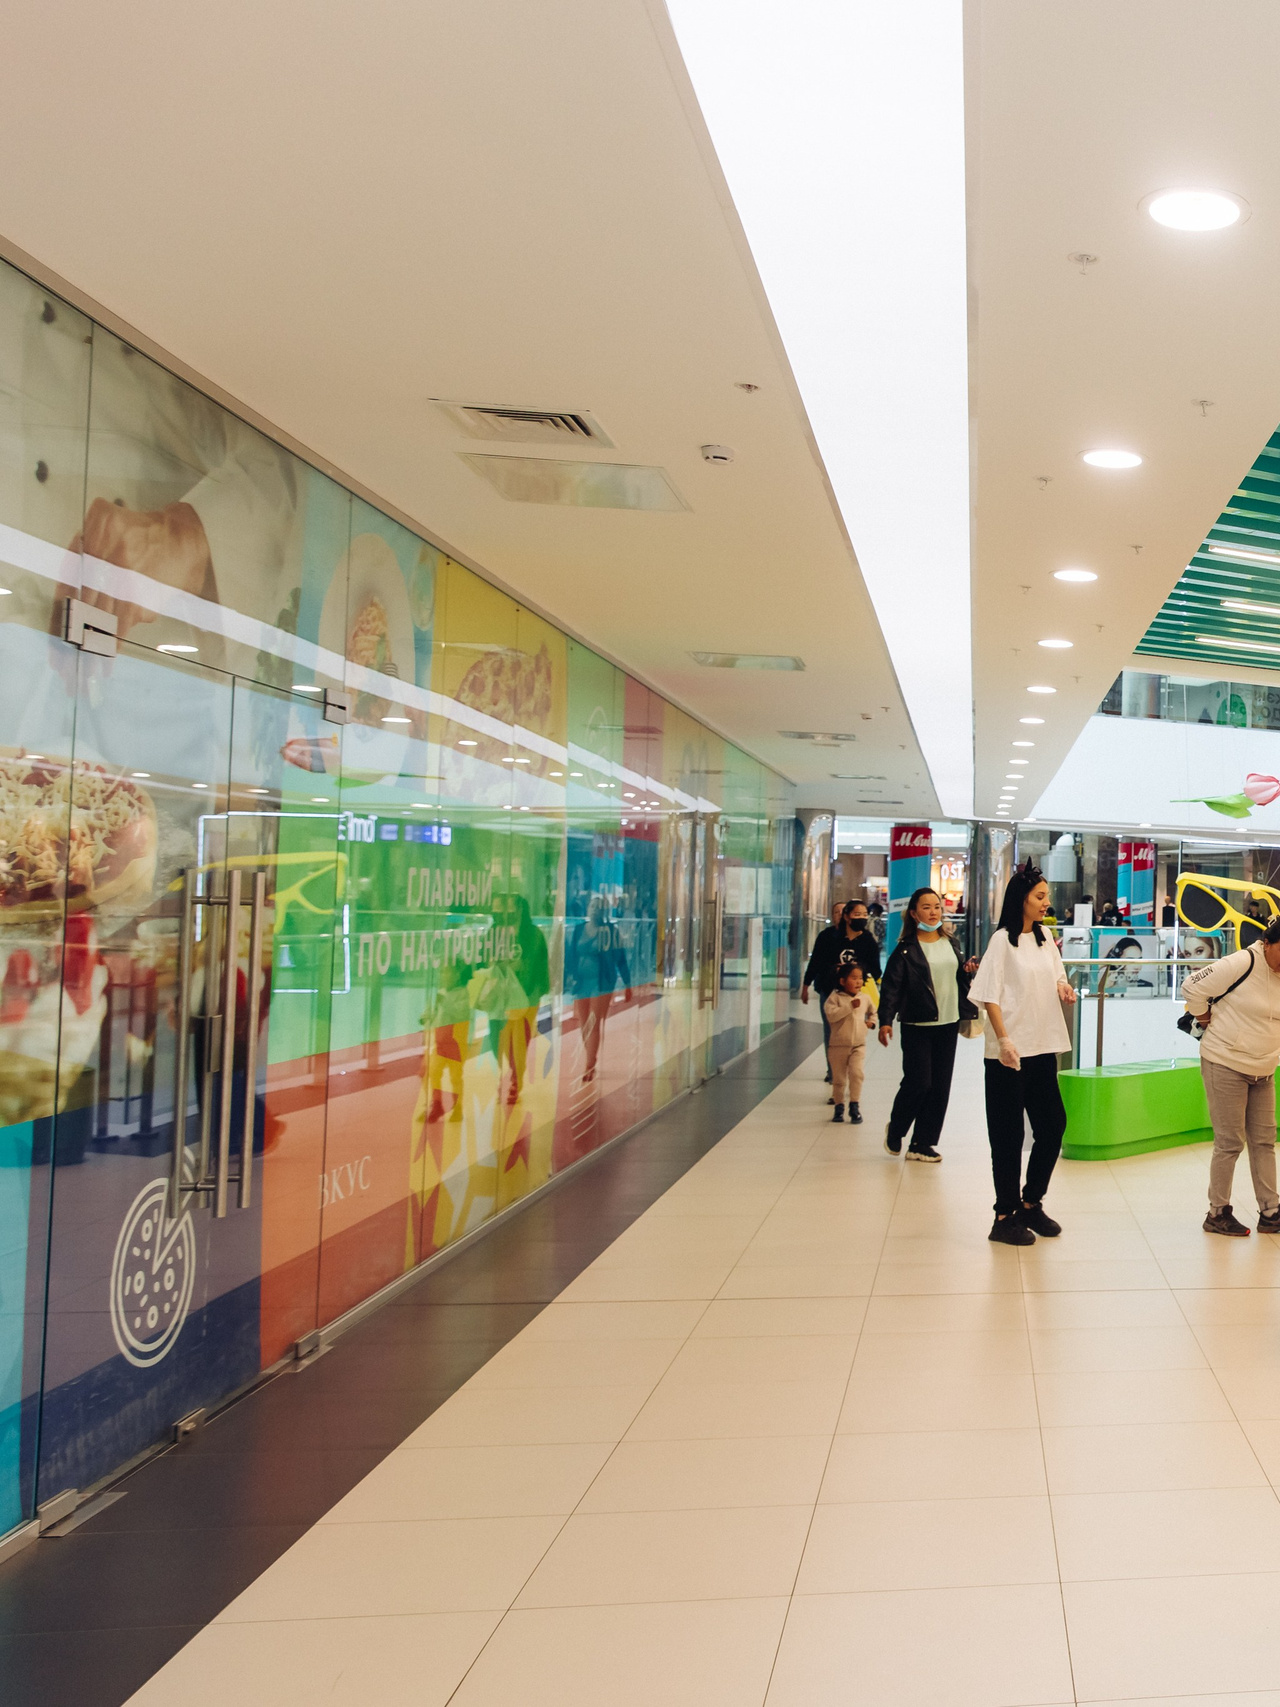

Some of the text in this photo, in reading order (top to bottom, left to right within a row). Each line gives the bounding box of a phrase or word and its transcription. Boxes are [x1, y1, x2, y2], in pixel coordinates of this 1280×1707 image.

[406, 863, 493, 908] ГЛАВНЫЙ
[358, 934, 392, 978] ПО
[318, 1155, 371, 1211] ВКУС
